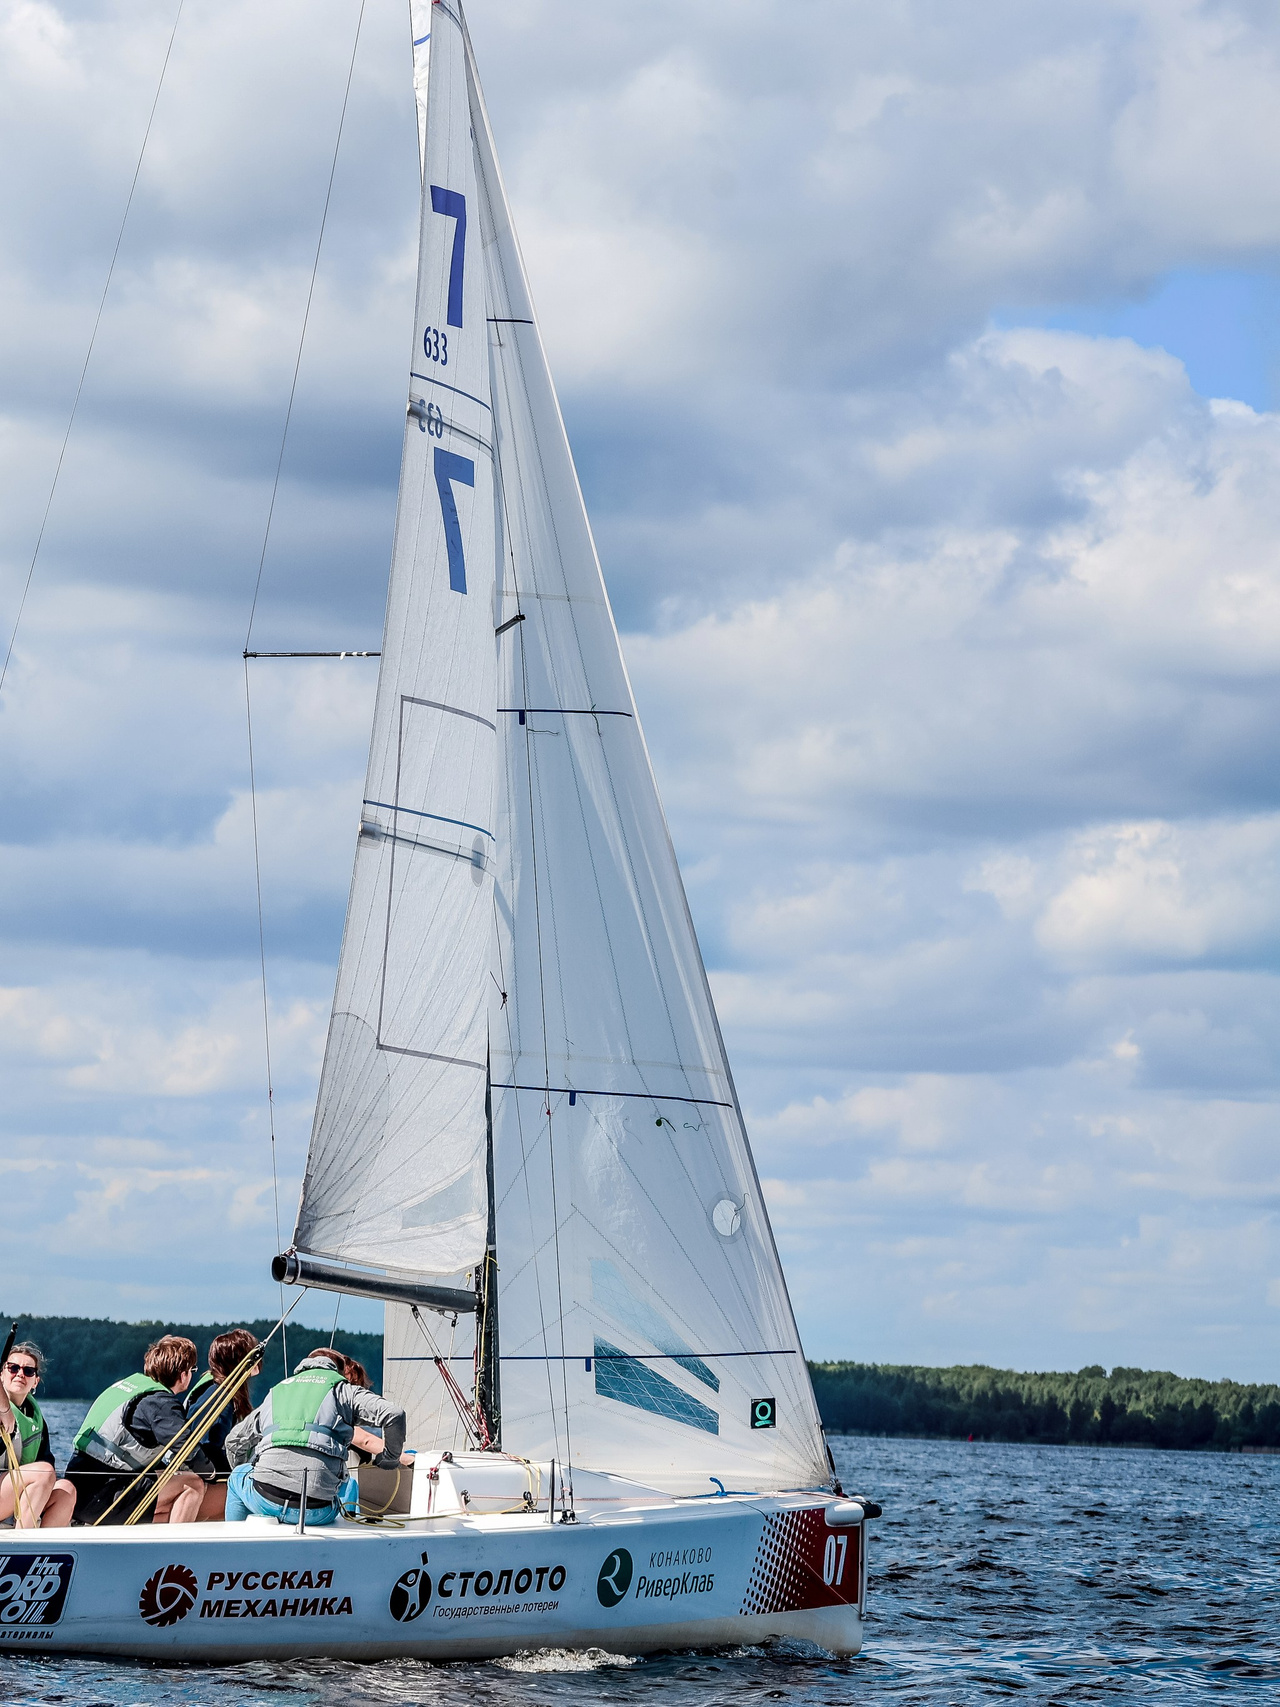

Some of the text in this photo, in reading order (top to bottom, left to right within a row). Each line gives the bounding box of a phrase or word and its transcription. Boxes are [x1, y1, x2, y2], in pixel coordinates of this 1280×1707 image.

[430, 184, 467, 329] 7
[423, 326, 448, 366] 633
[649, 1546, 713, 1569] КОНАКОВО
[822, 1534, 848, 1587] 07
[206, 1569, 335, 1591] РУССКАЯ
[437, 1564, 567, 1599] СТОЛОТО
[634, 1572, 715, 1601] РиверКлаб
[199, 1596, 354, 1618] МЕХАНИКА
[432, 1600, 560, 1620] Государственные лотереи
